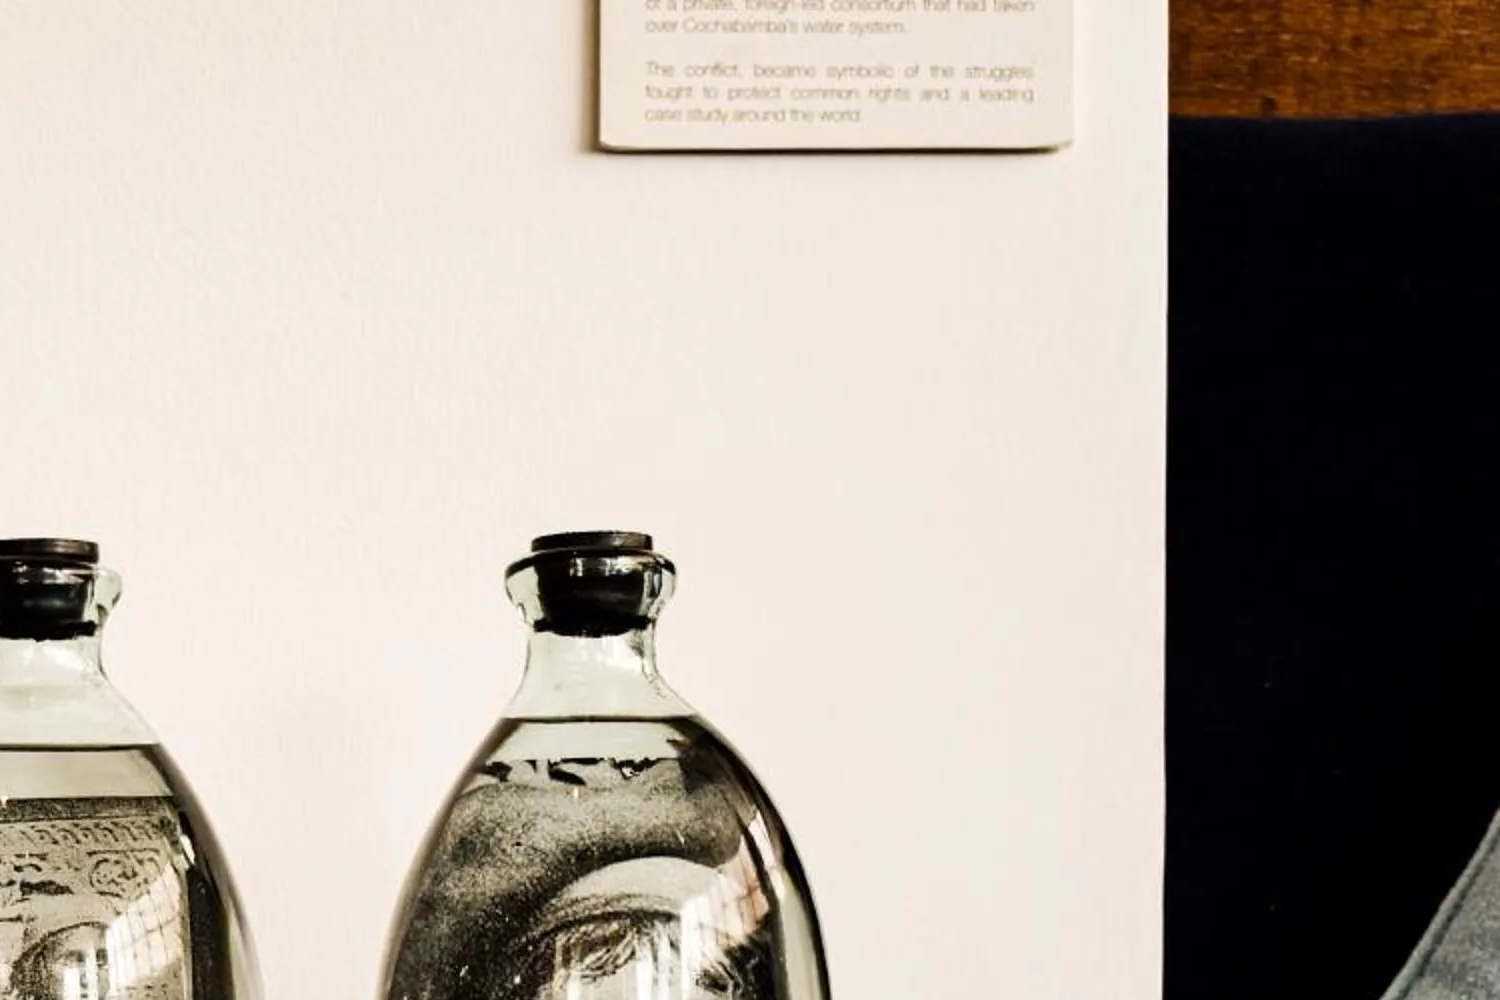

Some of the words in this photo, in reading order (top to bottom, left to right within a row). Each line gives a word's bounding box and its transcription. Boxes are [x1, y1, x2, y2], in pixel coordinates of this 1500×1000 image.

[922, 0, 951, 12] that
[956, 0, 987, 12] had
[645, 20, 678, 33] over
[682, 17, 799, 33] Cochabamba's
[802, 19, 845, 33] water
[848, 20, 907, 37] system.
[646, 61, 675, 78] The
[684, 62, 741, 79] conflict,
[753, 63, 817, 78] became
[826, 64, 893, 81] symbolic
[903, 64, 920, 79] of
[929, 65, 955, 79] the
[964, 65, 1034, 82] struggles
[644, 84, 693, 102] fought
[702, 86, 719, 99] to
[727, 86, 781, 103] protect
[790, 88, 857, 101] common
[867, 87, 911, 103] rights
[920, 88, 950, 101] and
[959, 89, 970, 101] a
[979, 88, 1034, 105] leading
[644, 109, 683, 122] case
[685, 108, 727, 126] study
[729, 108, 786, 123] around
[789, 108, 815, 123] the
